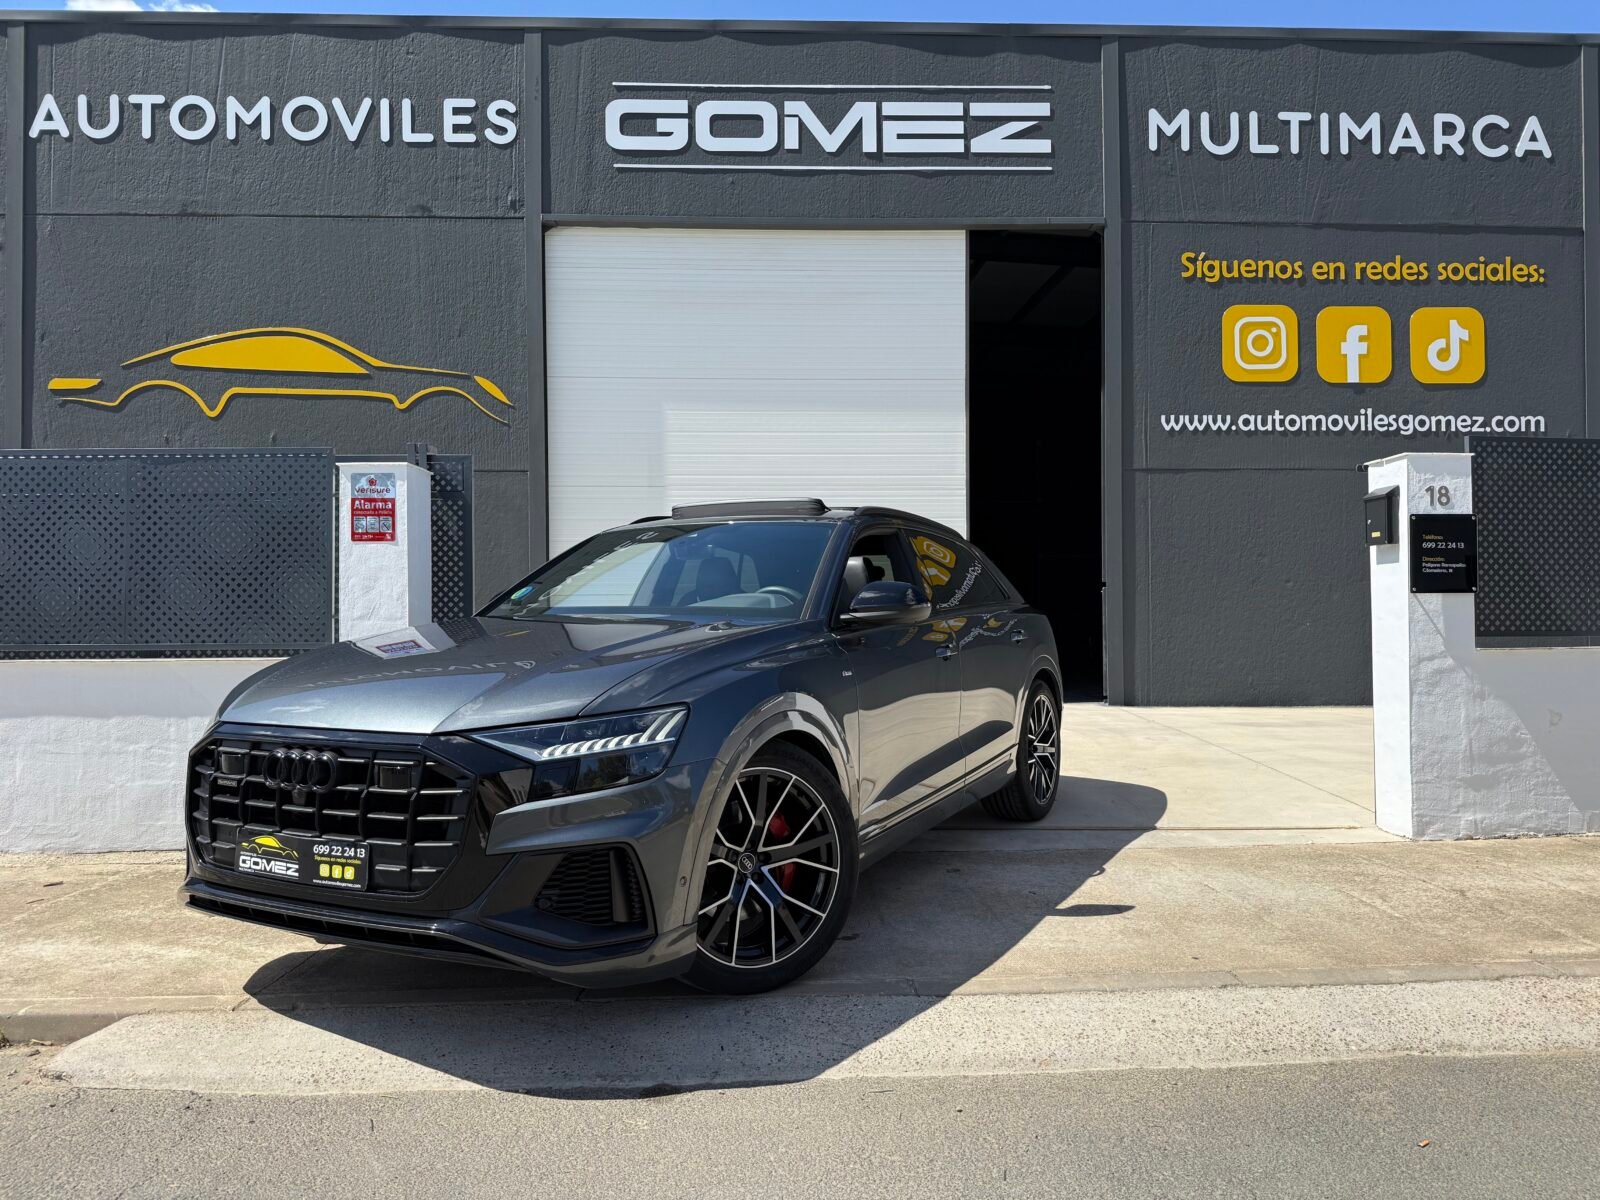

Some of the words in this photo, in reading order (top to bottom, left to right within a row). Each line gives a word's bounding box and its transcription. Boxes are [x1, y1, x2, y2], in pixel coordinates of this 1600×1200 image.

[29, 93, 518, 146] AUTOMOVILES
[604, 98, 1052, 154] GOMEZ
[1148, 108, 1552, 159] MULTIMARCA
[1181, 251, 1303, 283] Síguenos
[1311, 260, 1346, 281] en
[1355, 254, 1429, 281] redes
[1437, 256, 1546, 283] sociales:
[1160, 407, 1546, 436] www.automovilesgomez.com
[354, 500, 392, 510] Alarma
[1424, 485, 1451, 507] 18
[313, 844, 330, 855] 699
[331, 846, 342, 856] 22
[343, 847, 355, 857] 24
[357, 848, 366, 858] 13
[239, 855, 299, 877] GOMEZ
